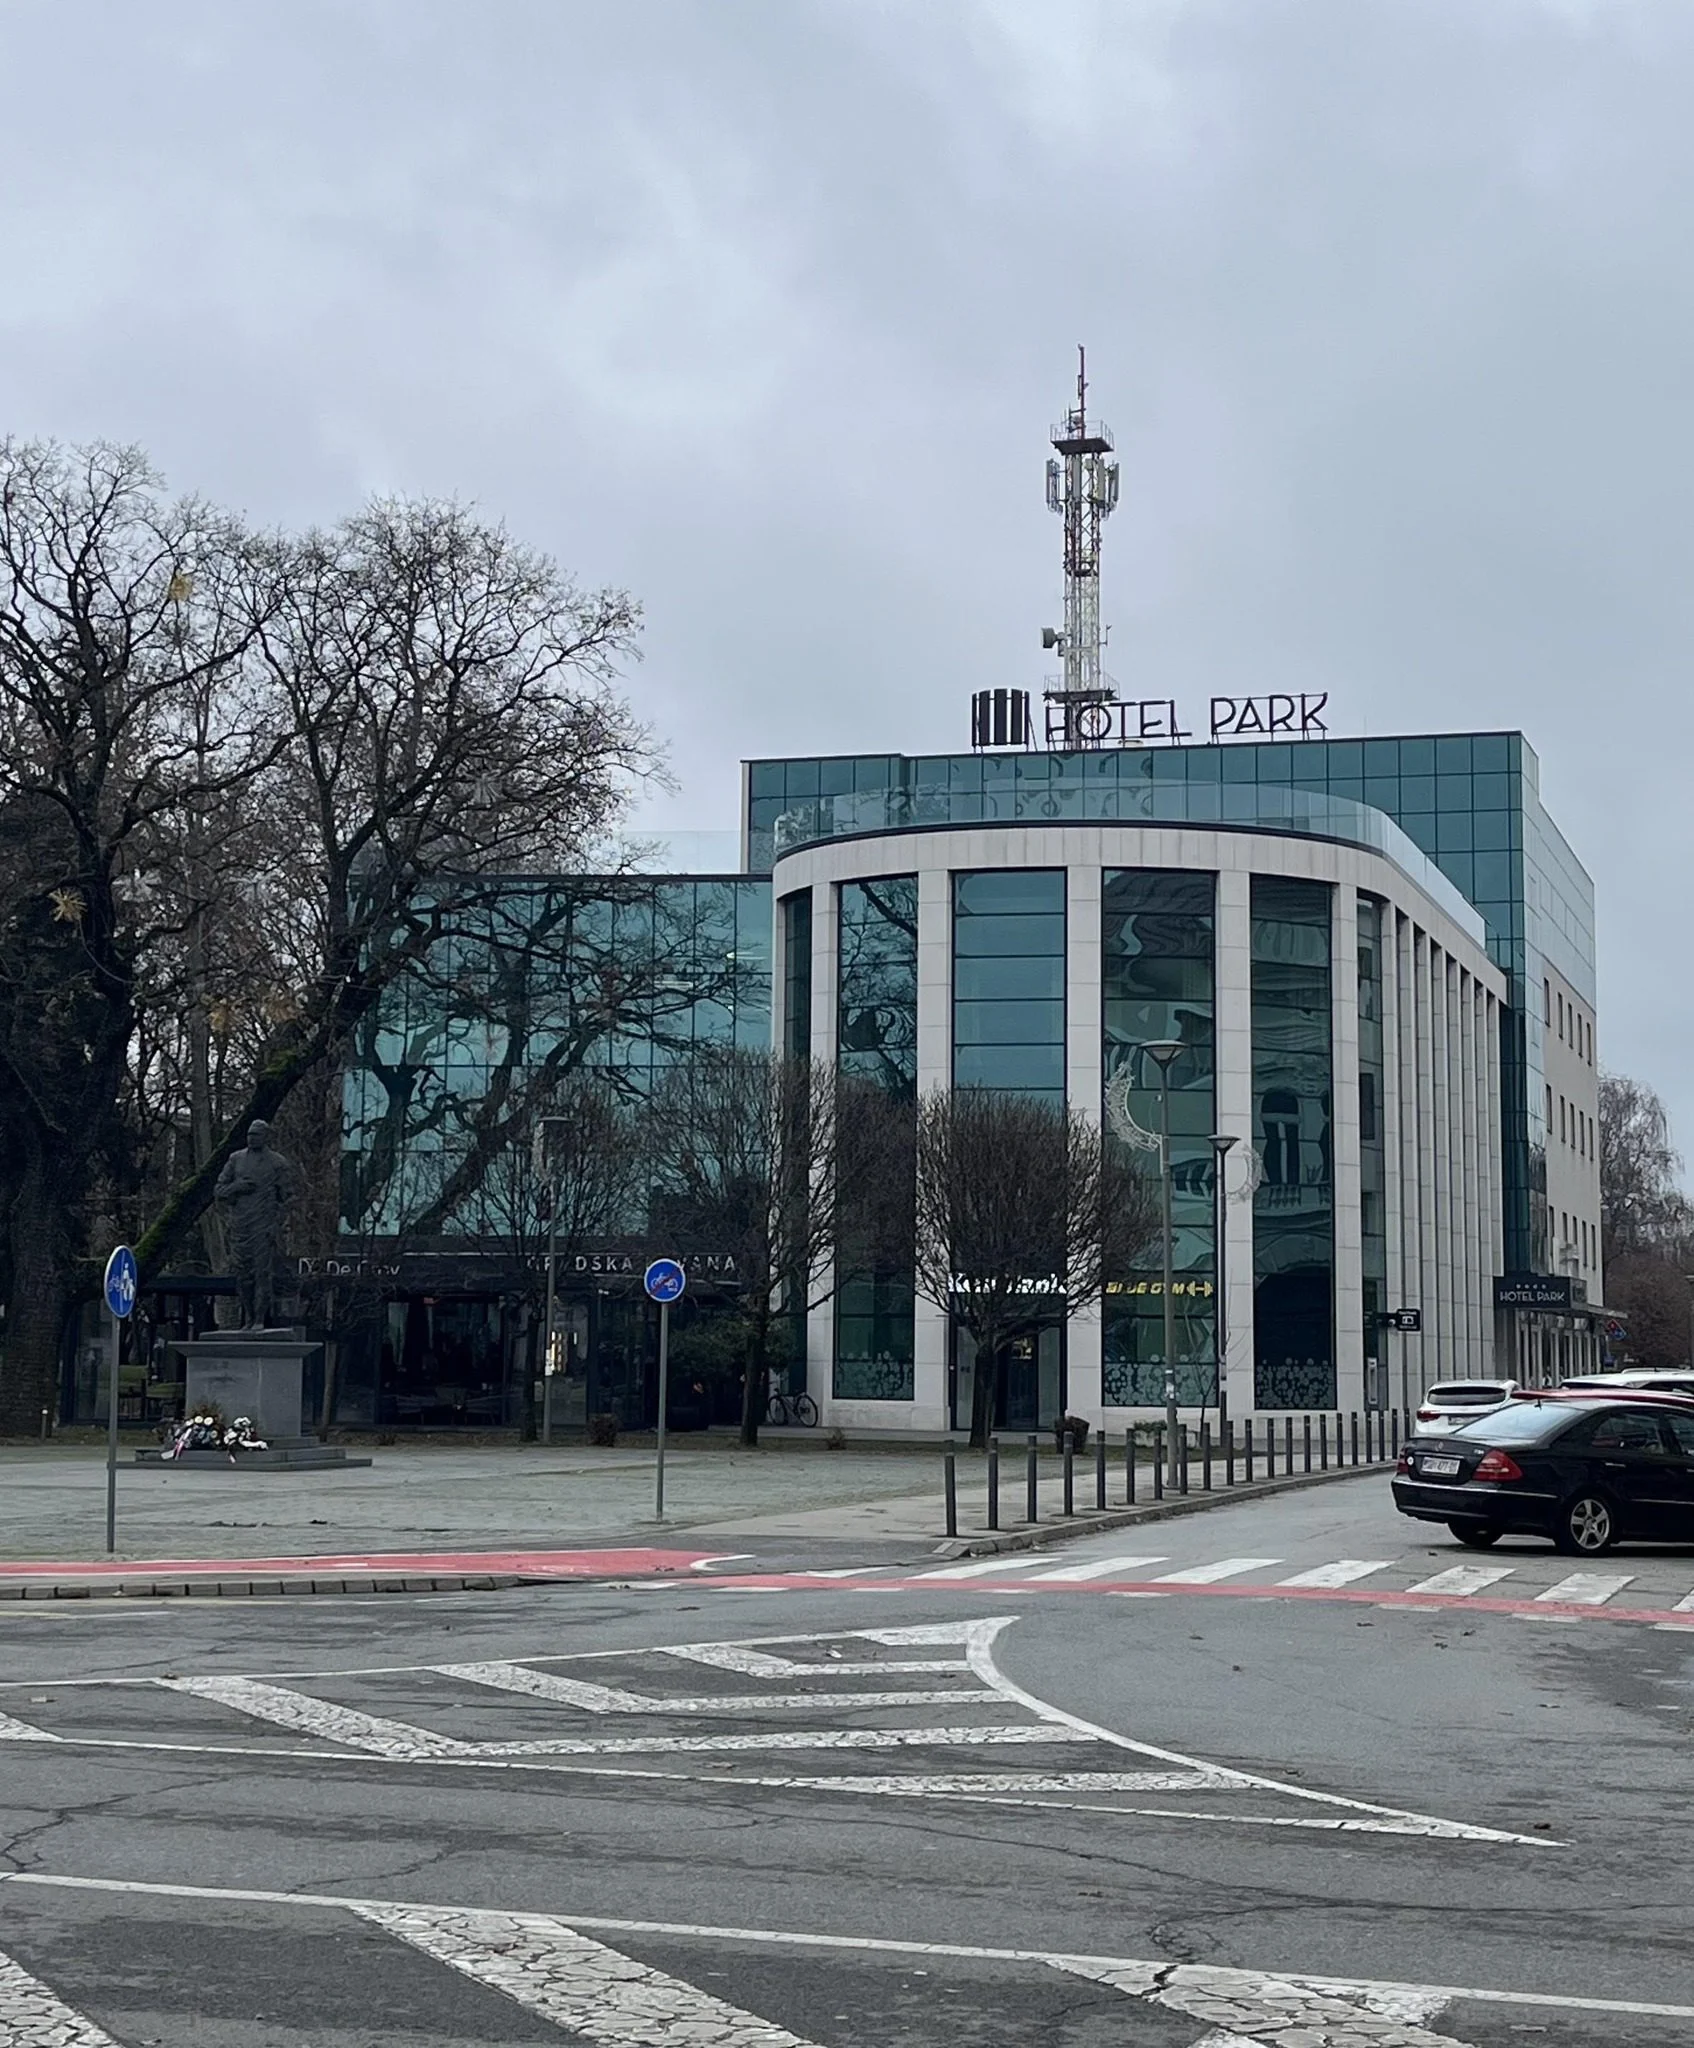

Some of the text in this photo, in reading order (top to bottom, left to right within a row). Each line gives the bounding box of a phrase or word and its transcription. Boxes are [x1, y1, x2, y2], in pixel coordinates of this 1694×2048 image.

[1046, 691, 1329, 743] HOTEL PARK
[1499, 1291, 1566, 1302] HOTEL PARK
